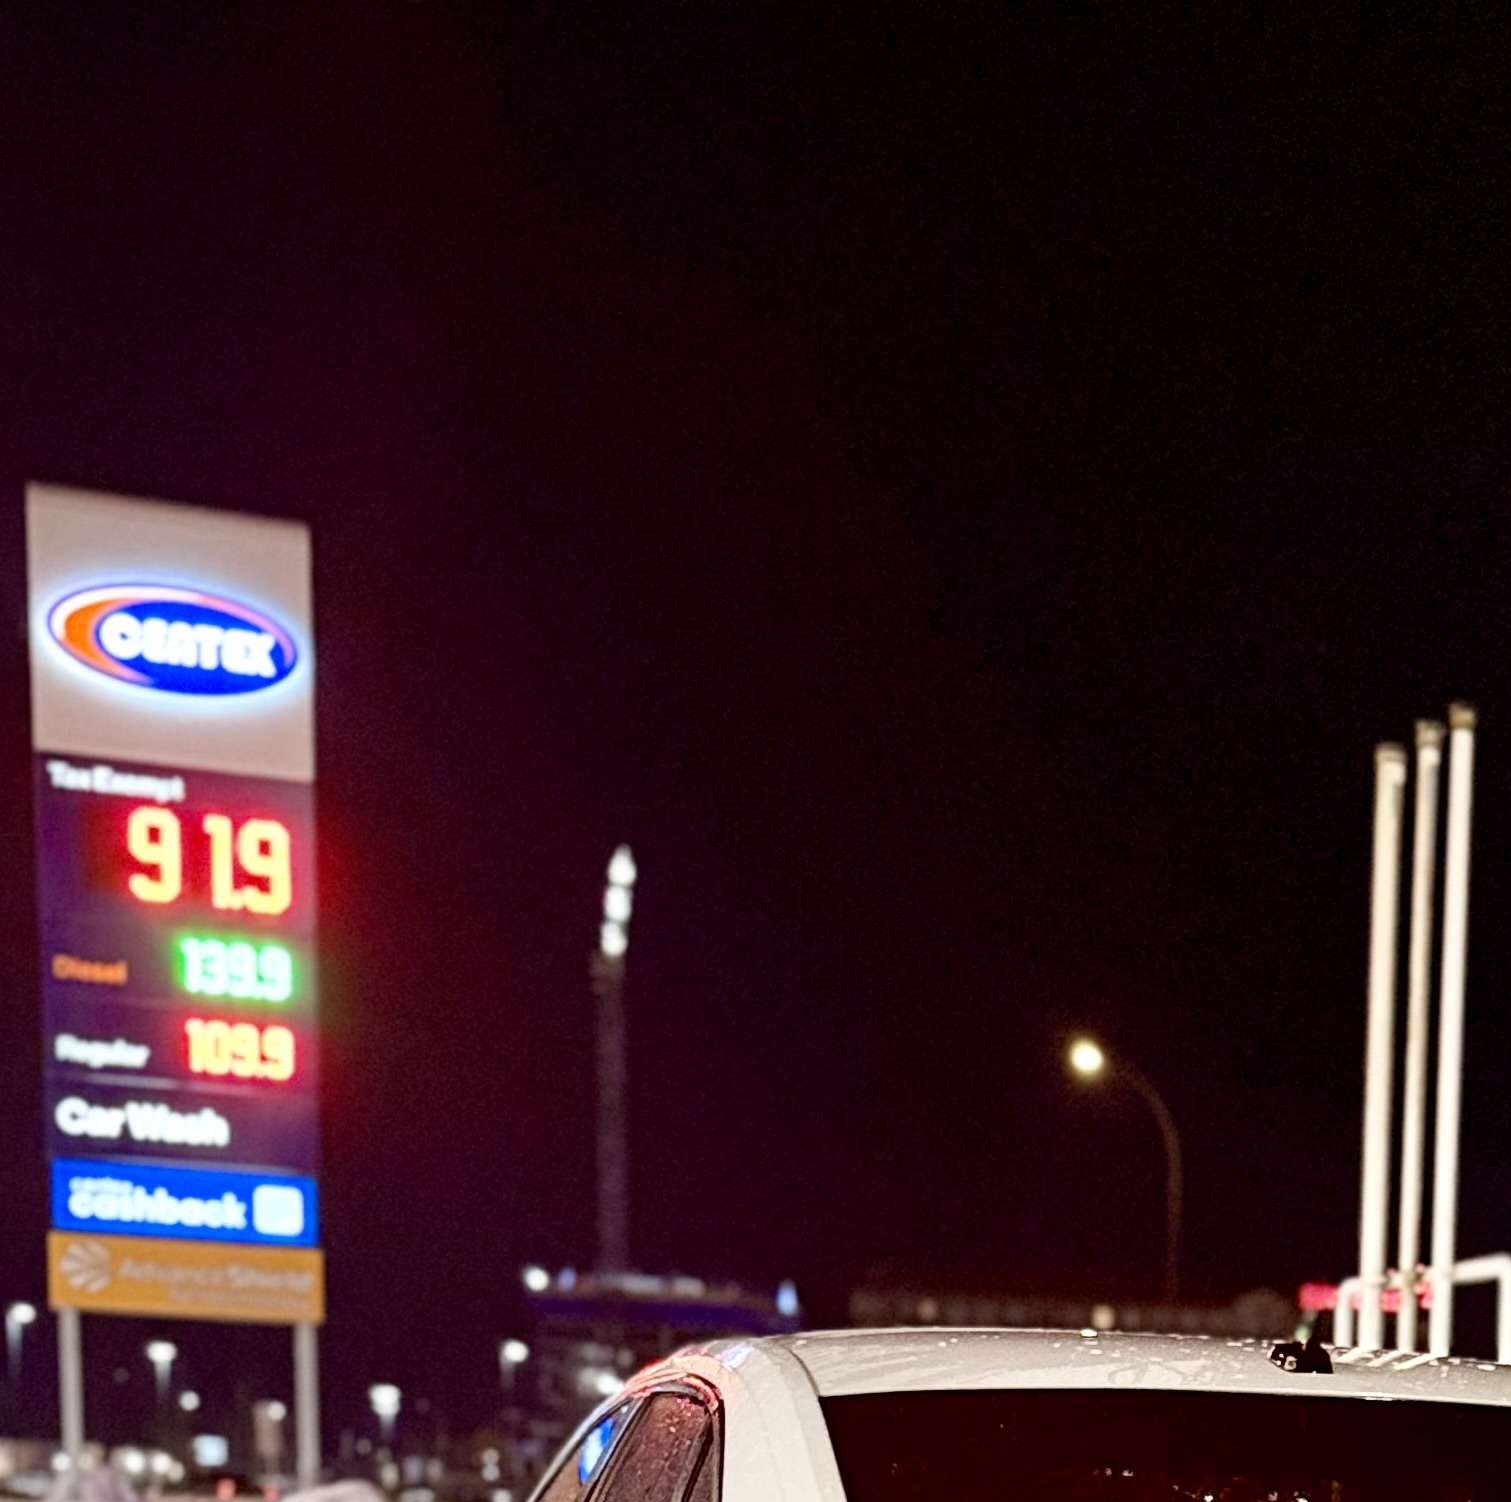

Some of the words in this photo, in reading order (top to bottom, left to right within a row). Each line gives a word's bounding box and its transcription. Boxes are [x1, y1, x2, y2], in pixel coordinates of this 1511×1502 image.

[181, 938, 293, 1002] 139.9
[185, 1018, 295, 1081] 109.9
[55, 1096, 124, 1139] Car
[125, 1101, 230, 1147] Wash
